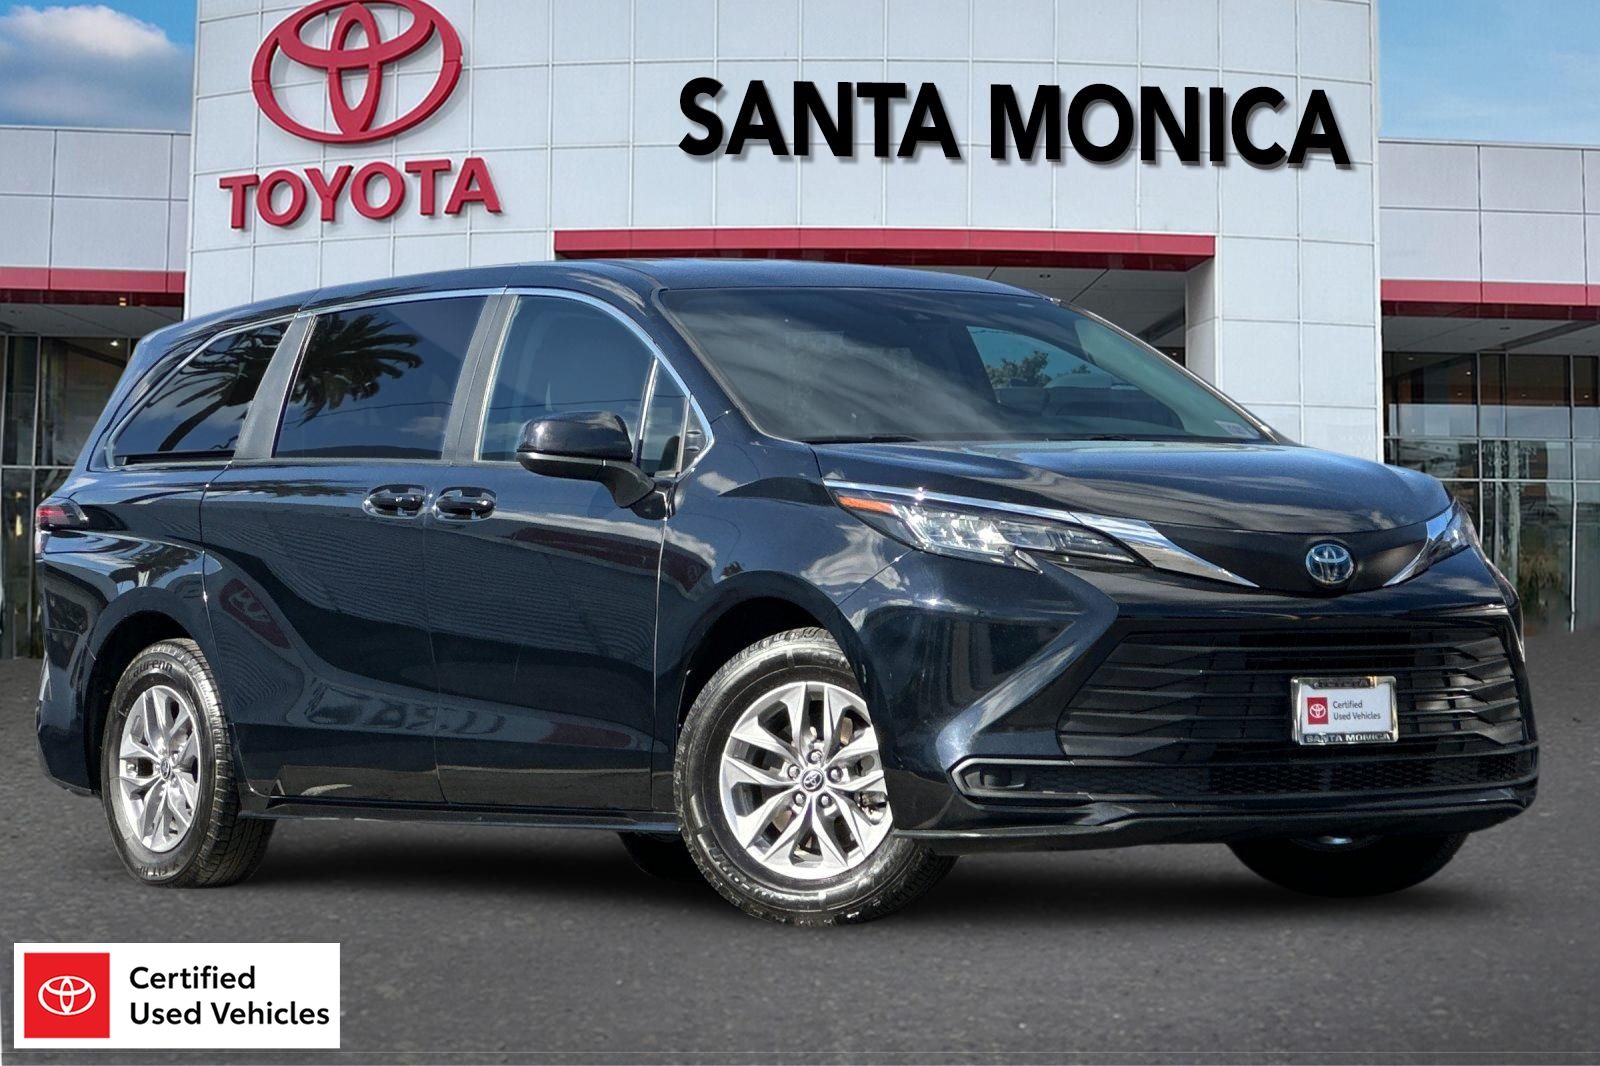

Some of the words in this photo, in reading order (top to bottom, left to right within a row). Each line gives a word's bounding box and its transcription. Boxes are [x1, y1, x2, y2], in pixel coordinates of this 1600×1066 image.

[678, 77, 961, 159] SANTA
[990, 83, 1351, 168] MONICA
[219, 157, 502, 229] TOYOTA
[1333, 700, 1363, 709] Certified
[1333, 712, 1351, 721] Used
[1352, 711, 1381, 720] Vehicles
[1306, 734, 1343, 743] SANTA
[1345, 733, 1390, 742] MONICA
